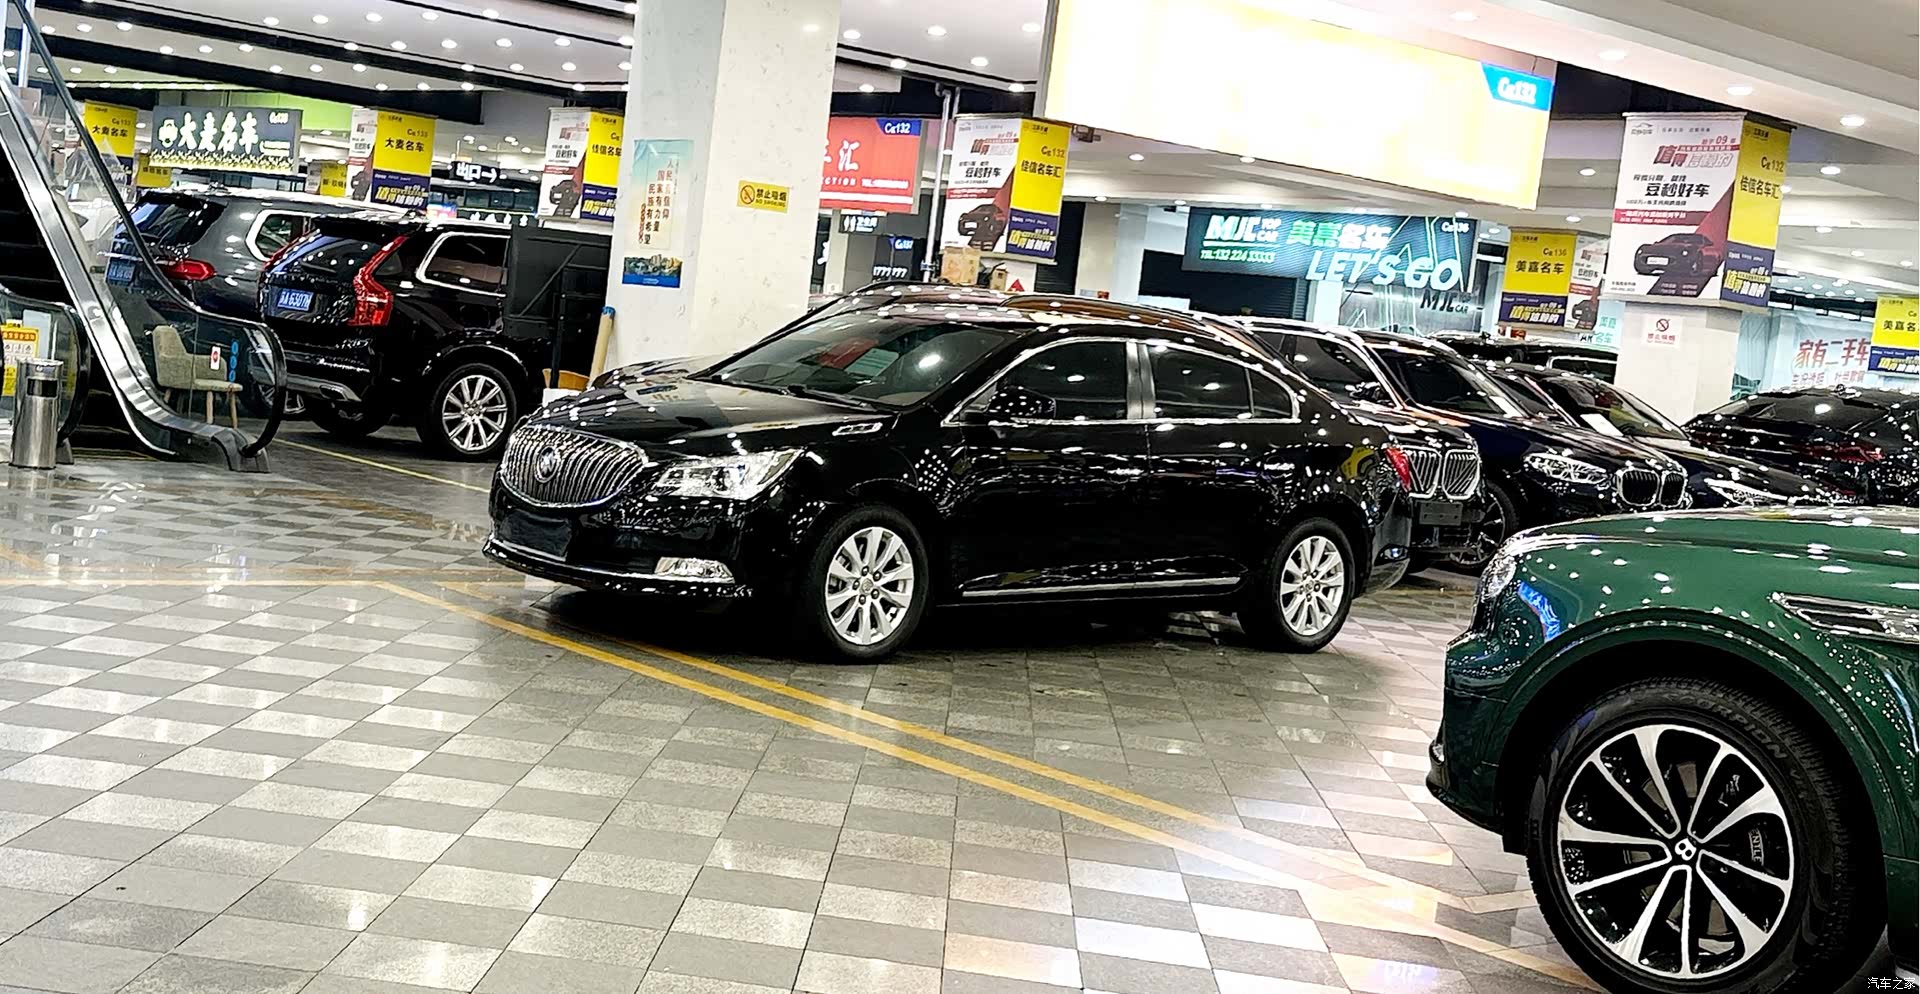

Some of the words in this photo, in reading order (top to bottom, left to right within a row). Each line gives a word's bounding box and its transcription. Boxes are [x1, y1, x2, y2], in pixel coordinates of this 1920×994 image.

[385, 137, 425, 152] 大麦名车
[456, 162, 481, 180] 出口
[1021, 160, 1062, 178] 佳信名车汇
[1645, 183, 1710, 198] 豆秒好车
[1740, 175, 1780, 200] 佳信名车汇
[1286, 219, 1393, 251] 美嘉名车
[1305, 250, 1403, 286] LET'S
[1404, 257, 1462, 292] GO
[1515, 260, 1566, 275] 美嘉名车
[1795, 339, 1871, 368] 家有二手车
